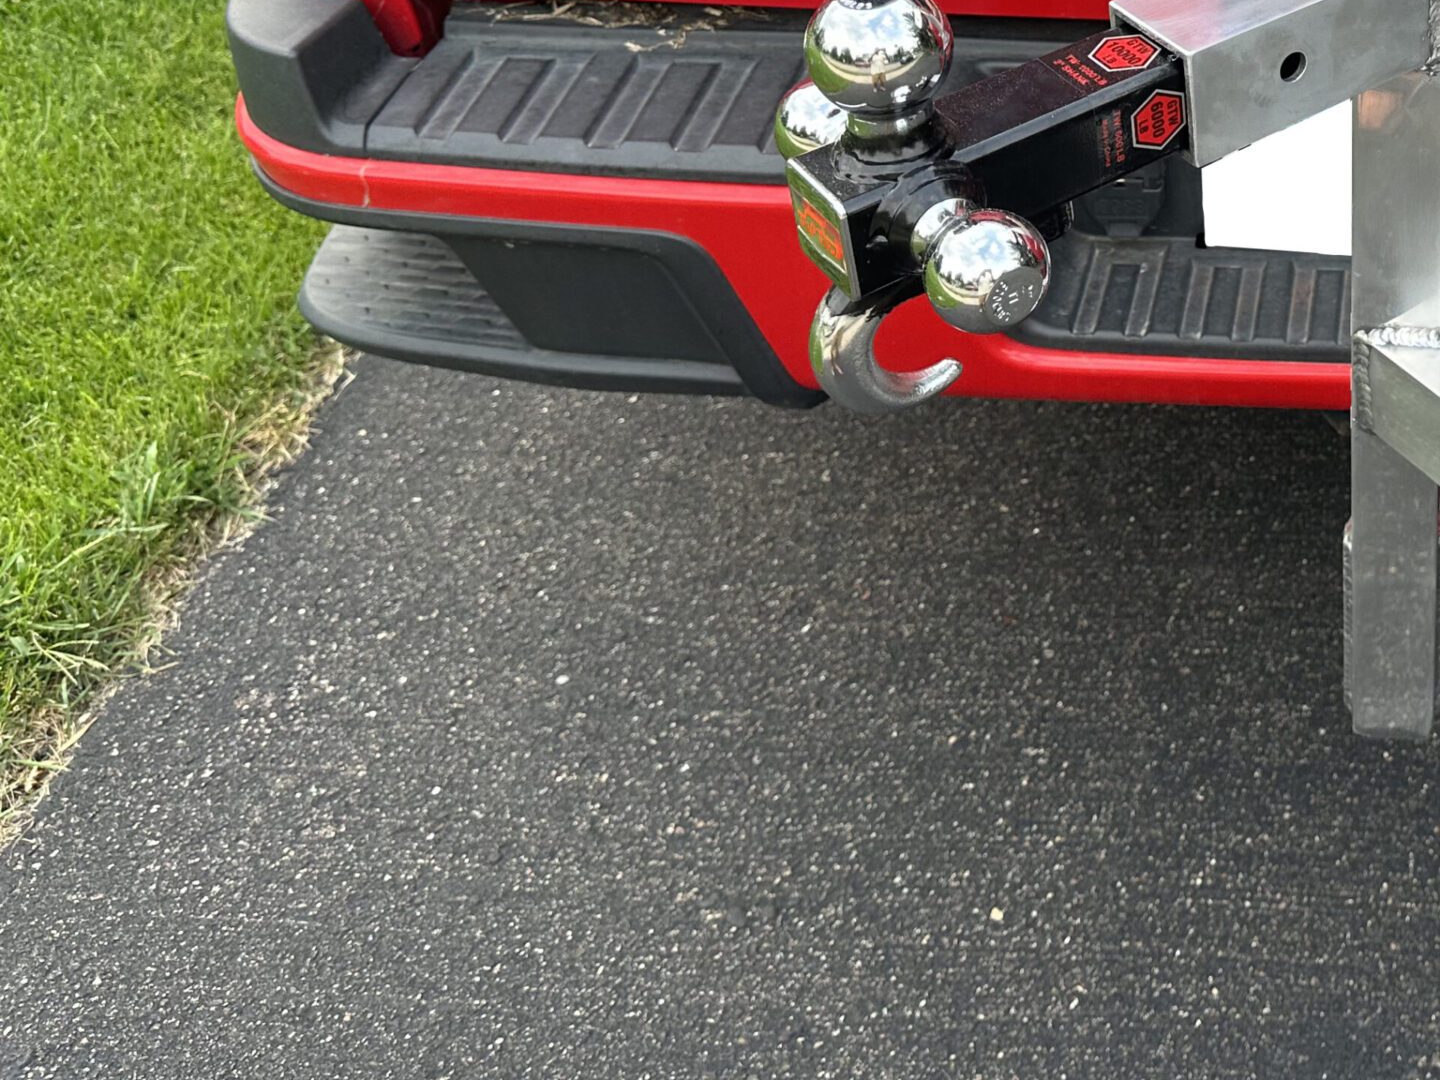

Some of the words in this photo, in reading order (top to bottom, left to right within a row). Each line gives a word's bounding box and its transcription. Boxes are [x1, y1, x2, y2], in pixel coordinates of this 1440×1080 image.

[1107, 41, 1141, 65] 10000
[1127, 38, 1150, 55] GTW
[1150, 101, 1165, 138] 6000
[1166, 100, 1178, 125] GTW
[1138, 120, 1149, 134] LB
